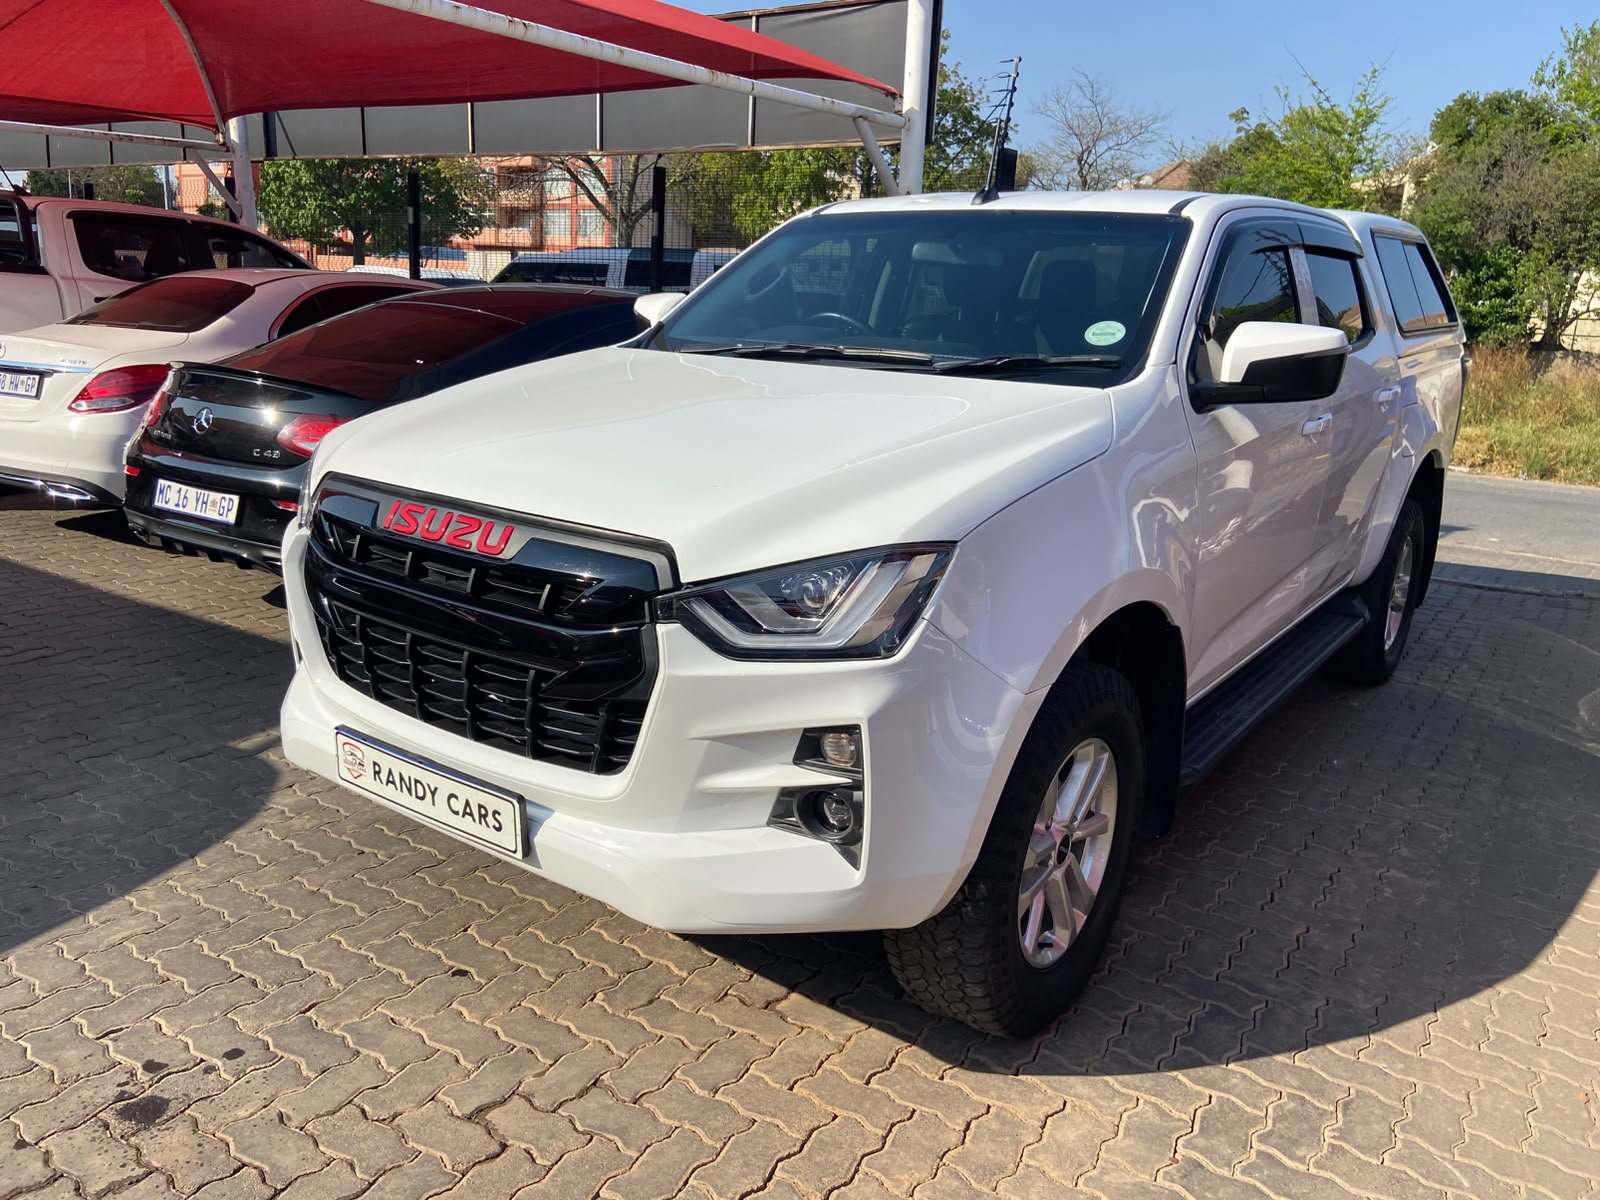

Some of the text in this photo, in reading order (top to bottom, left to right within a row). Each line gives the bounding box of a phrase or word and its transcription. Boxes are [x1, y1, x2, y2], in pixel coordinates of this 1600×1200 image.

[9, 375, 21, 392] HW
[25, 376, 37, 393] GP
[253, 448, 260, 457] C
[157, 482, 234, 518] MC 16 YH GP
[383, 499, 515, 556] ISUZU
[372, 760, 503, 833] RANDY CARS
